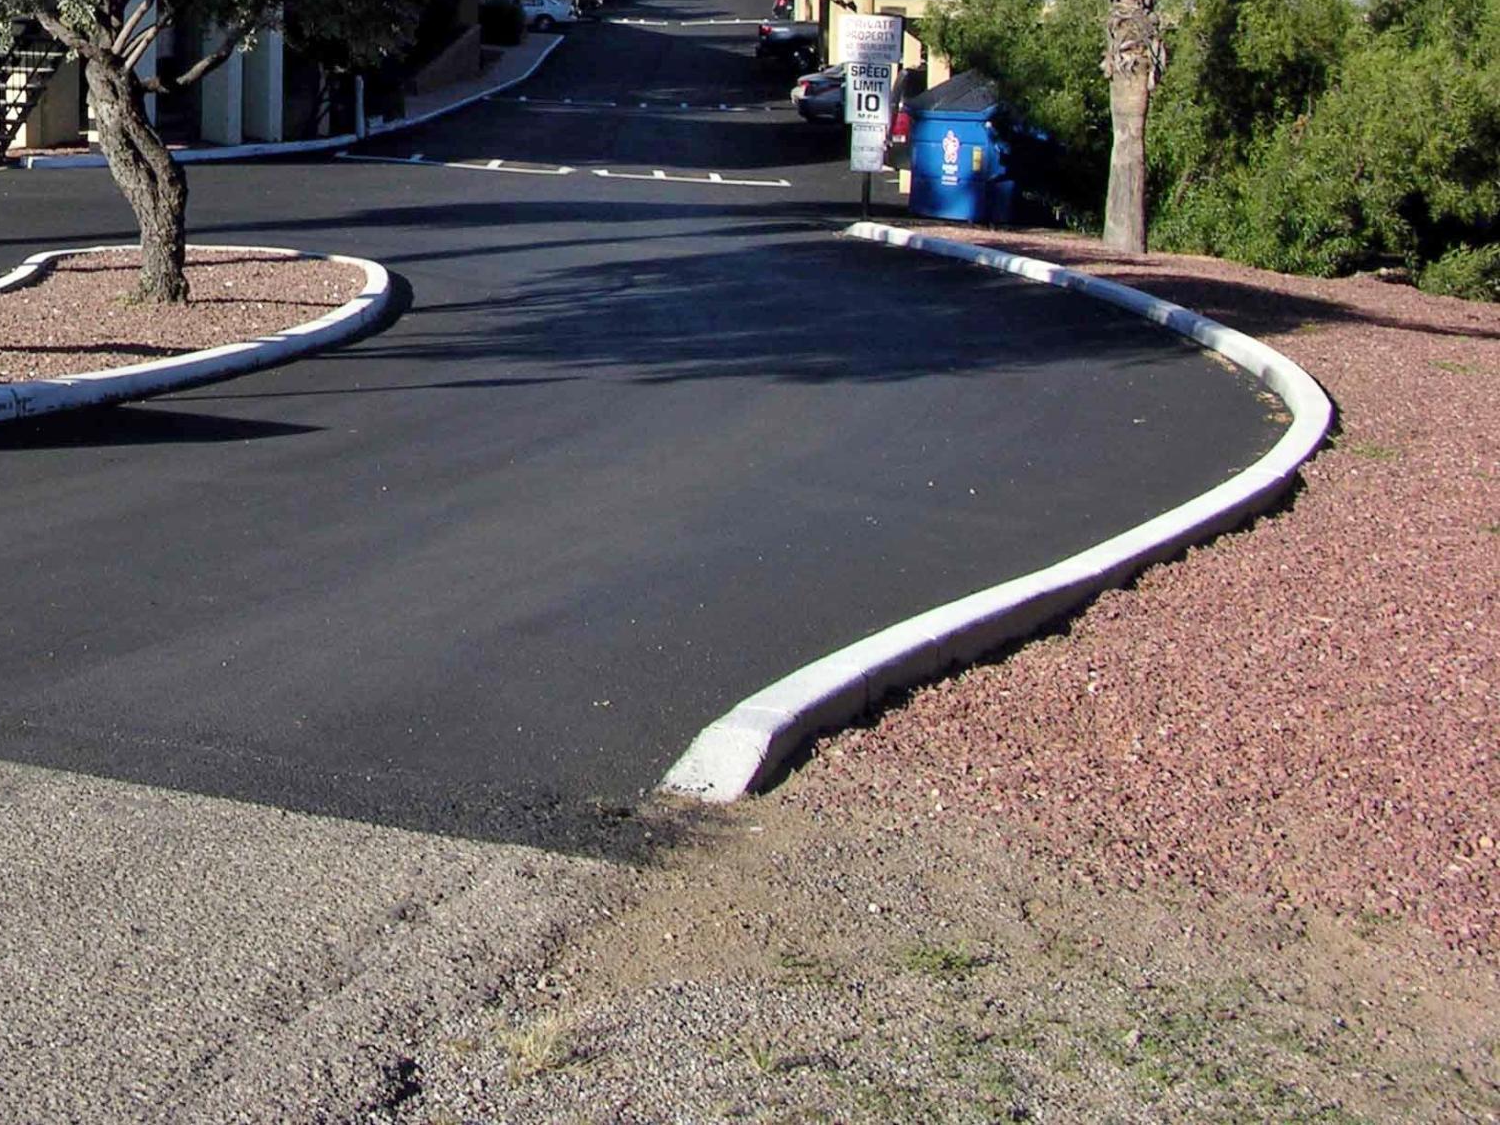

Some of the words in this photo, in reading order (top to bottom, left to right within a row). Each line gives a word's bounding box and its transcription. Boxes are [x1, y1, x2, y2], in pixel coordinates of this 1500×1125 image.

[851, 65, 889, 78] SPEED
[853, 79, 884, 92] LIMIT
[857, 93, 880, 112] 10
